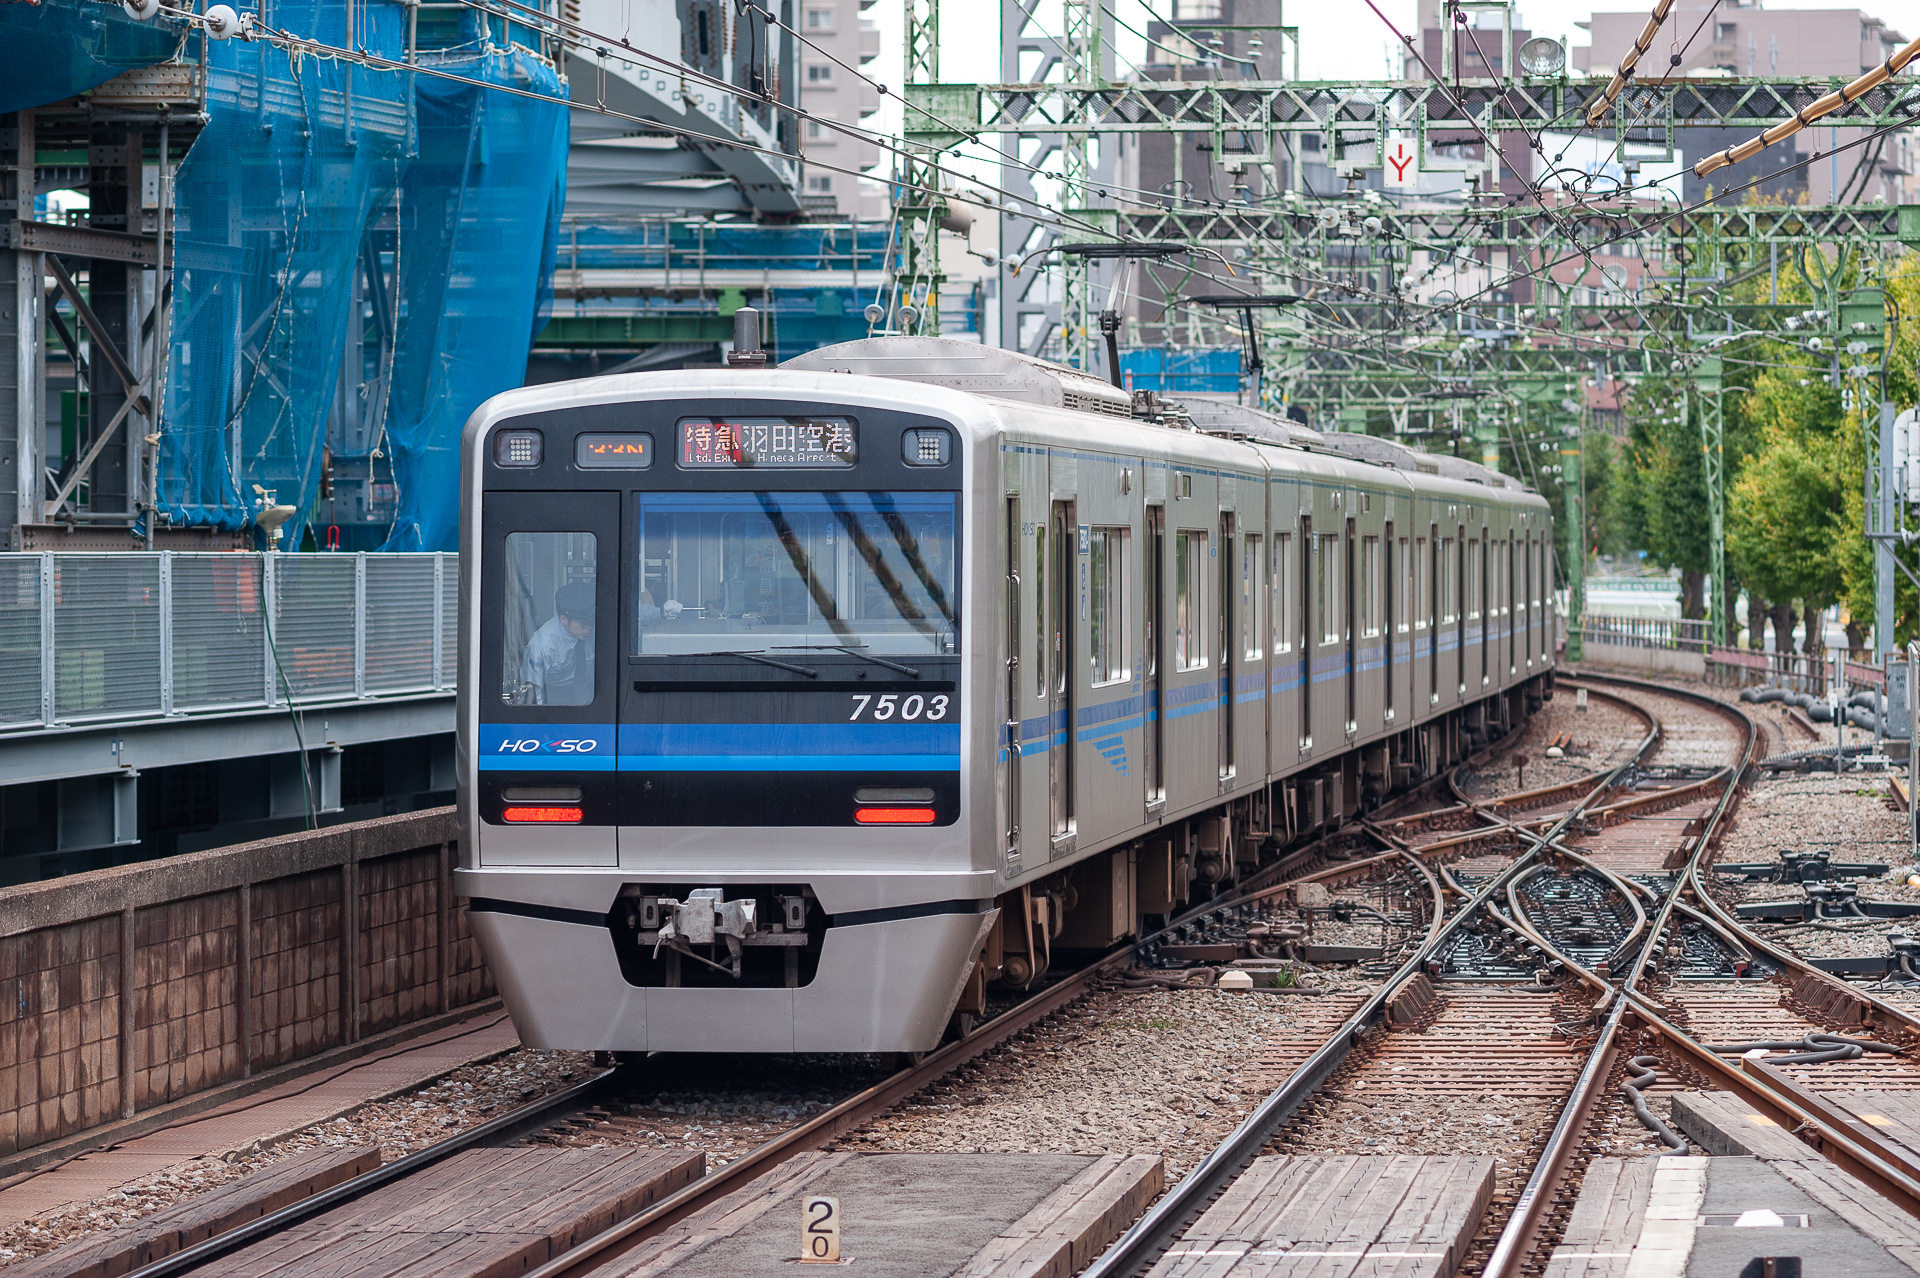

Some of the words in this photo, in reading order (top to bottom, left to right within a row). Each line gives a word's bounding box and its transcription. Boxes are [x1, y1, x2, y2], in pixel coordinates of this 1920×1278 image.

[743, 423, 851, 452] 羽田空港
[757, 452, 794, 462] Hnea
[849, 694, 949, 721] 7503
[808, 1201, 833, 1234] 2
[812, 1236, 829, 1258] 0
